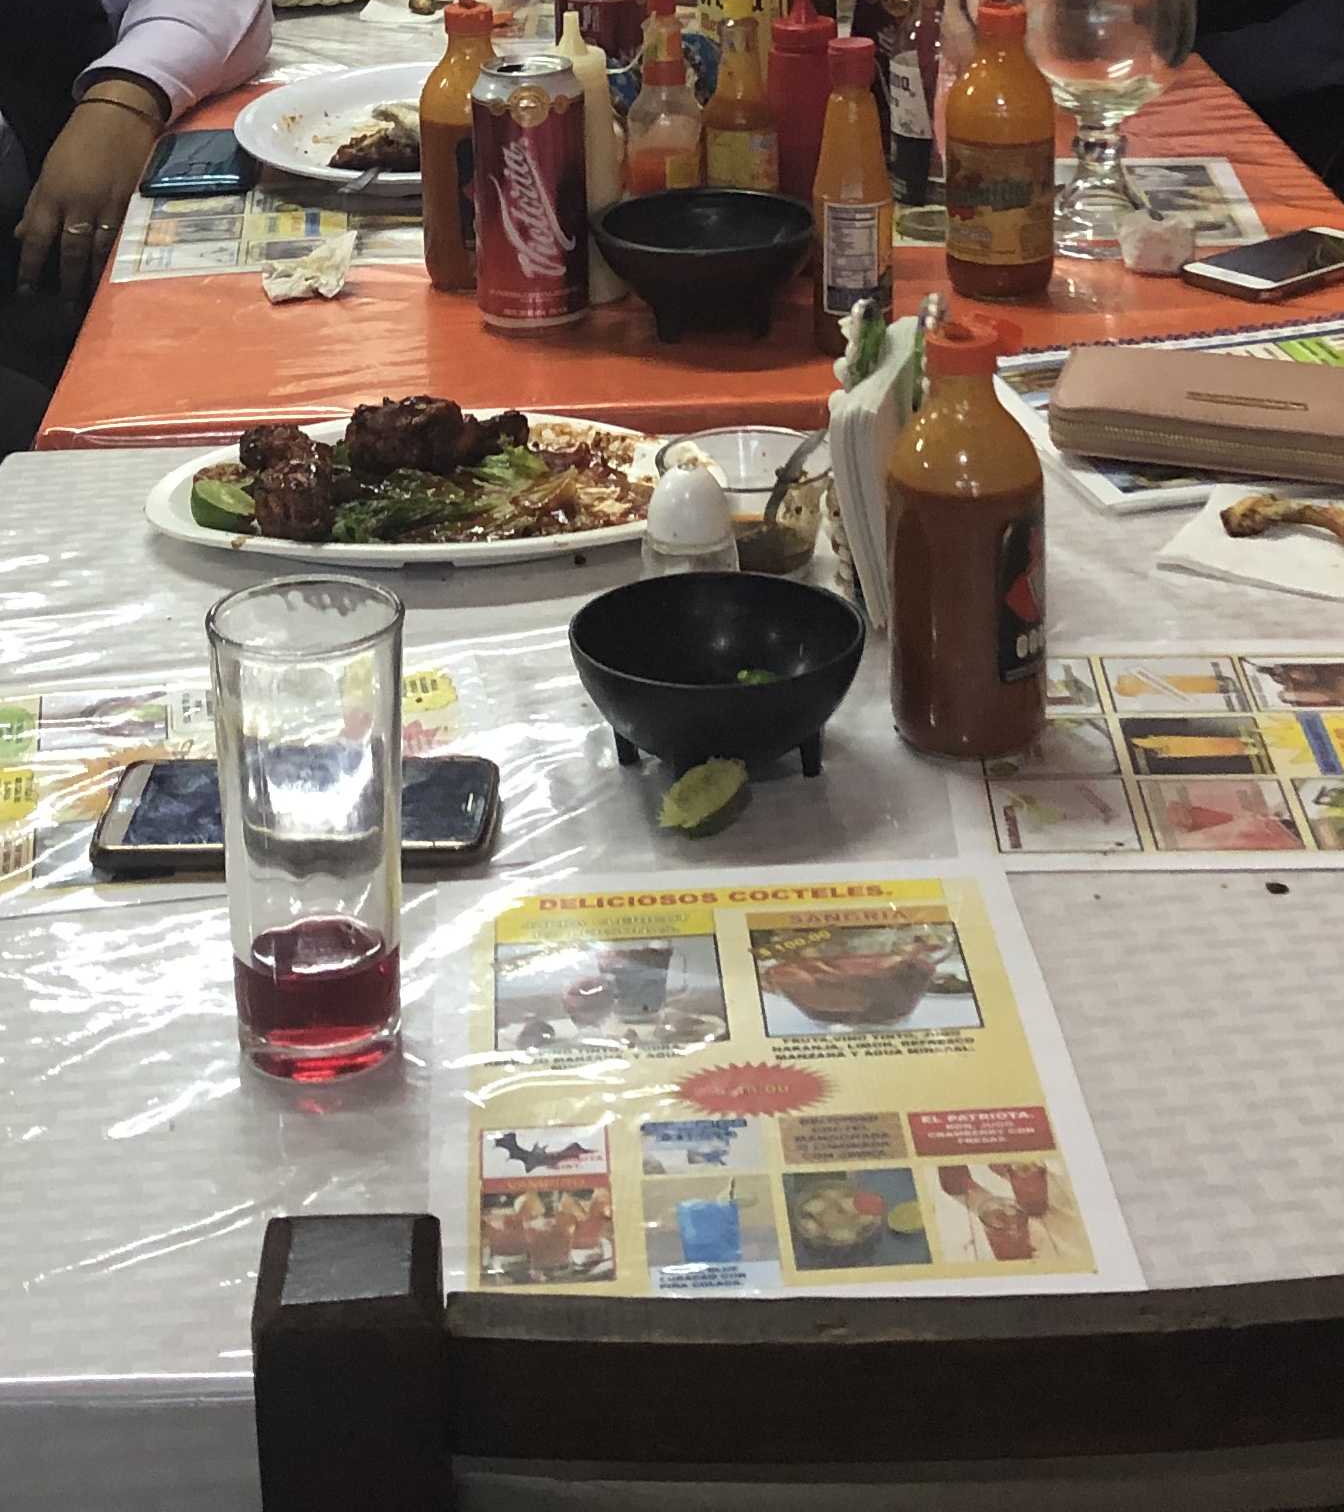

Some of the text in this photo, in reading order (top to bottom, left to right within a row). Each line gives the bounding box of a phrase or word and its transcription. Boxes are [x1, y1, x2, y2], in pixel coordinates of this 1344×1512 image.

[490, 137, 576, 278] Victoria
[539, 884, 893, 911] DELICIOSOS COCTELES.
[788, 906, 909, 924] SANGRIA
[921, 1115, 943, 1124] EL
